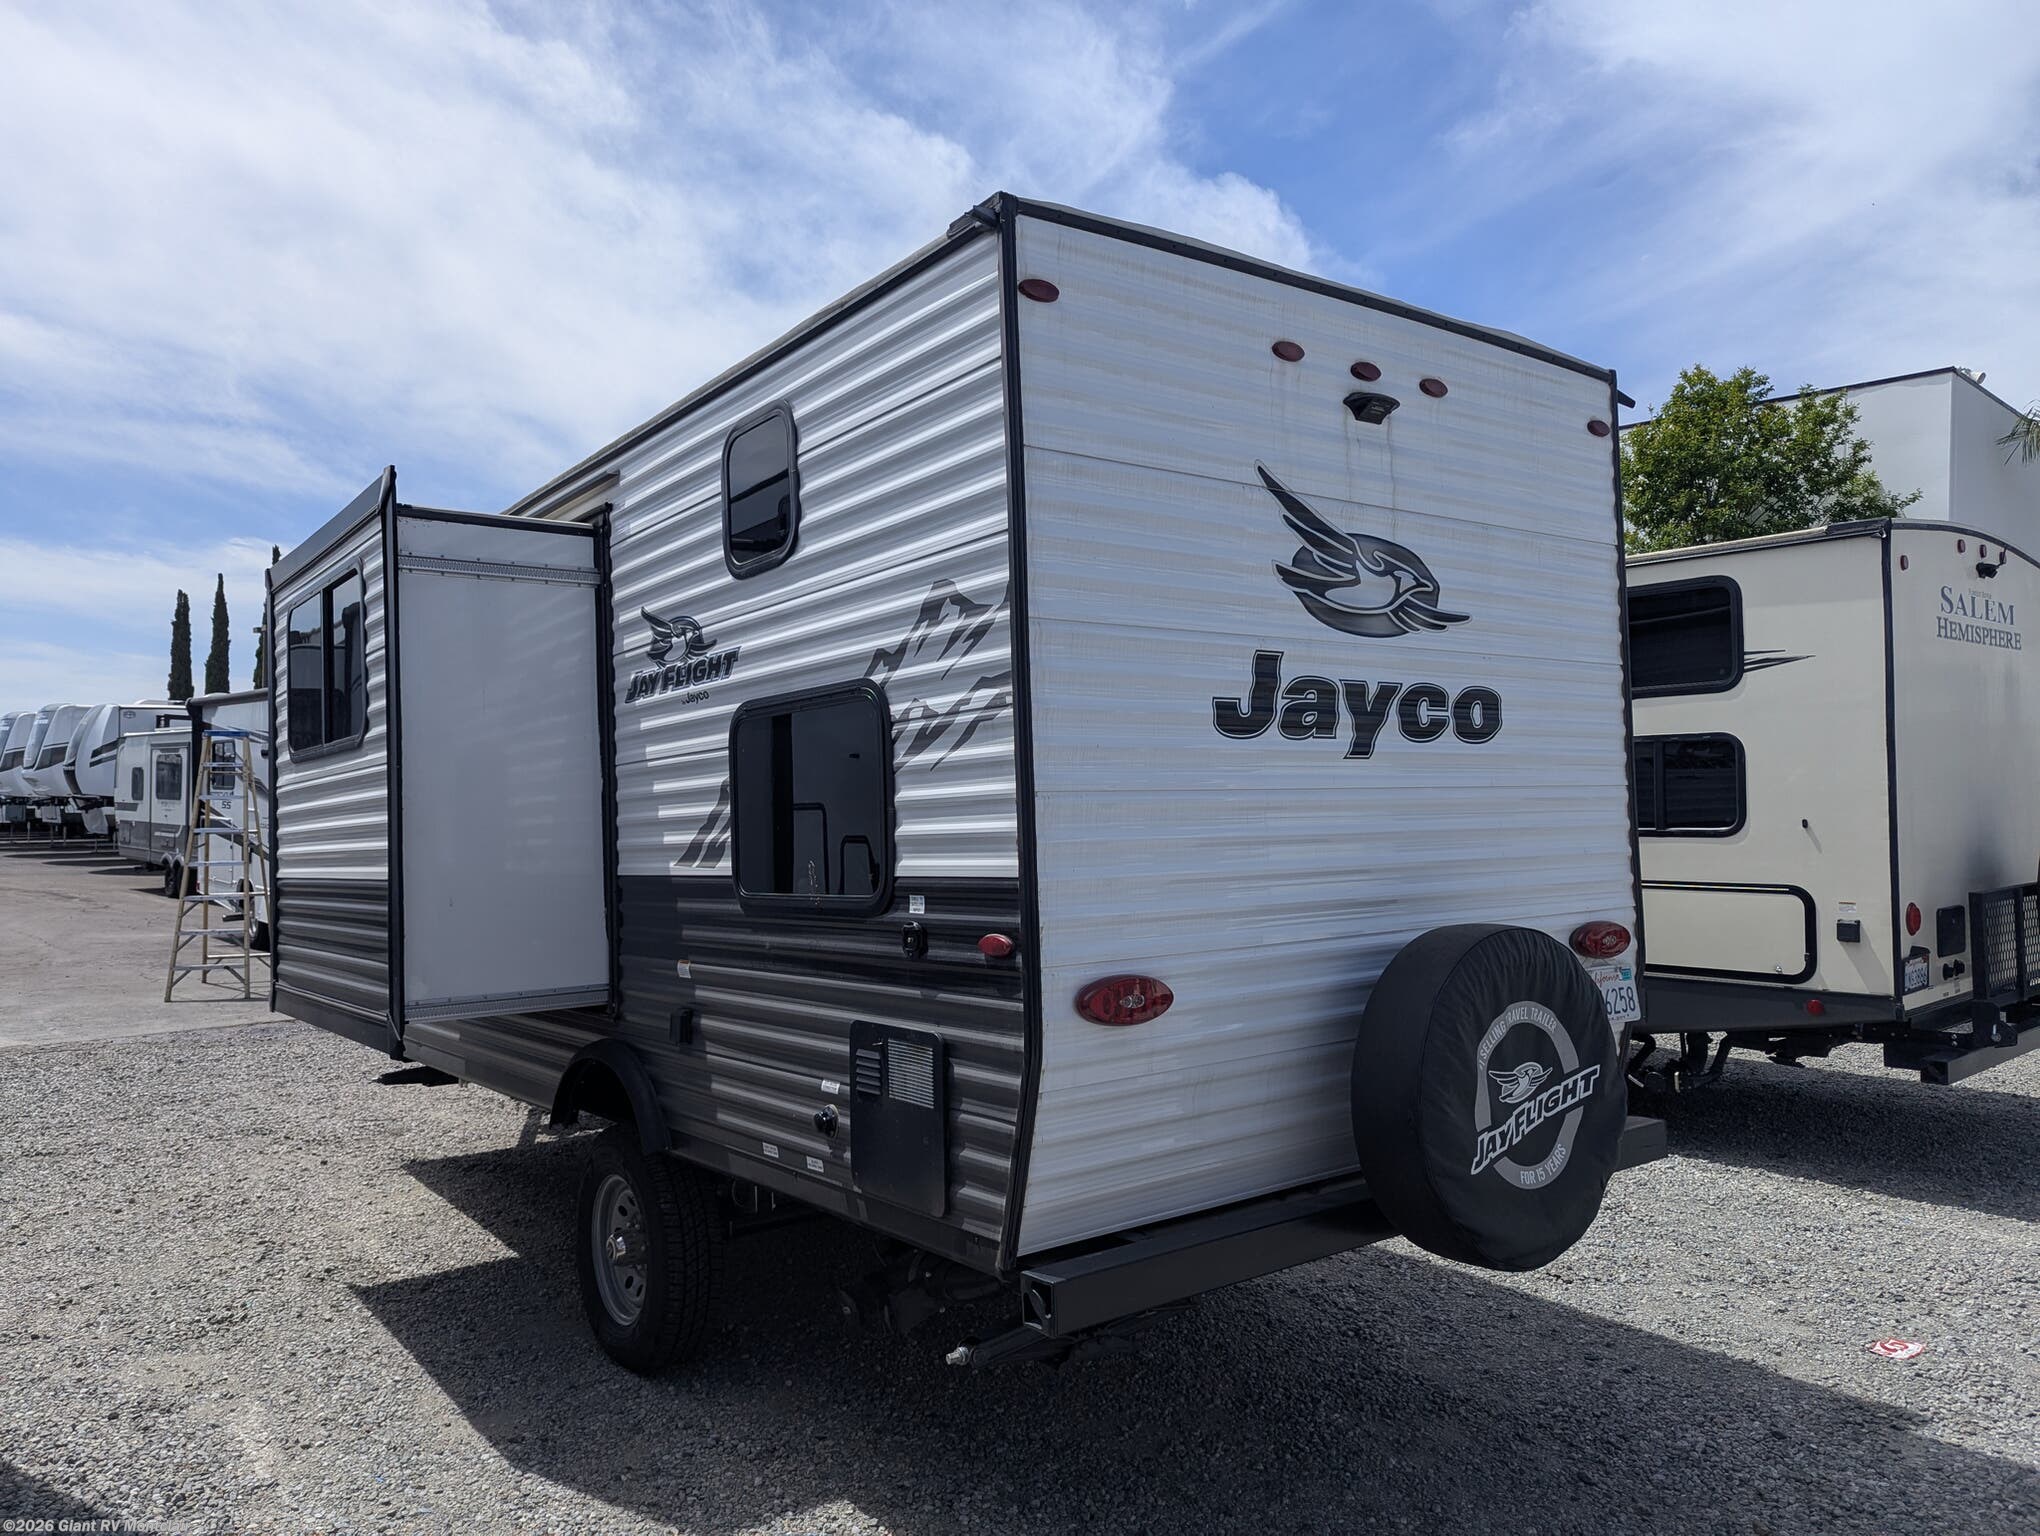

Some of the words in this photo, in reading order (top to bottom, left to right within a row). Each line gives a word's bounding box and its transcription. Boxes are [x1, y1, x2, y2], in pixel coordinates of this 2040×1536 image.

[1940, 585, 2015, 626] SALEM
[1936, 615, 2022, 651] HEMISPHERE
[686, 690, 710, 705] Jayco
[1211, 649, 1503, 760] Jayco
[1605, 986, 1636, 1015] 6258
[1480, 1021, 1507, 1060] SELLING
[1531, 1007, 1557, 1033] TRAILER
[1520, 1170, 1536, 1185] FOR
[1536, 1168, 1546, 1182] 15
[1544, 1143, 1566, 1176] YEARS
